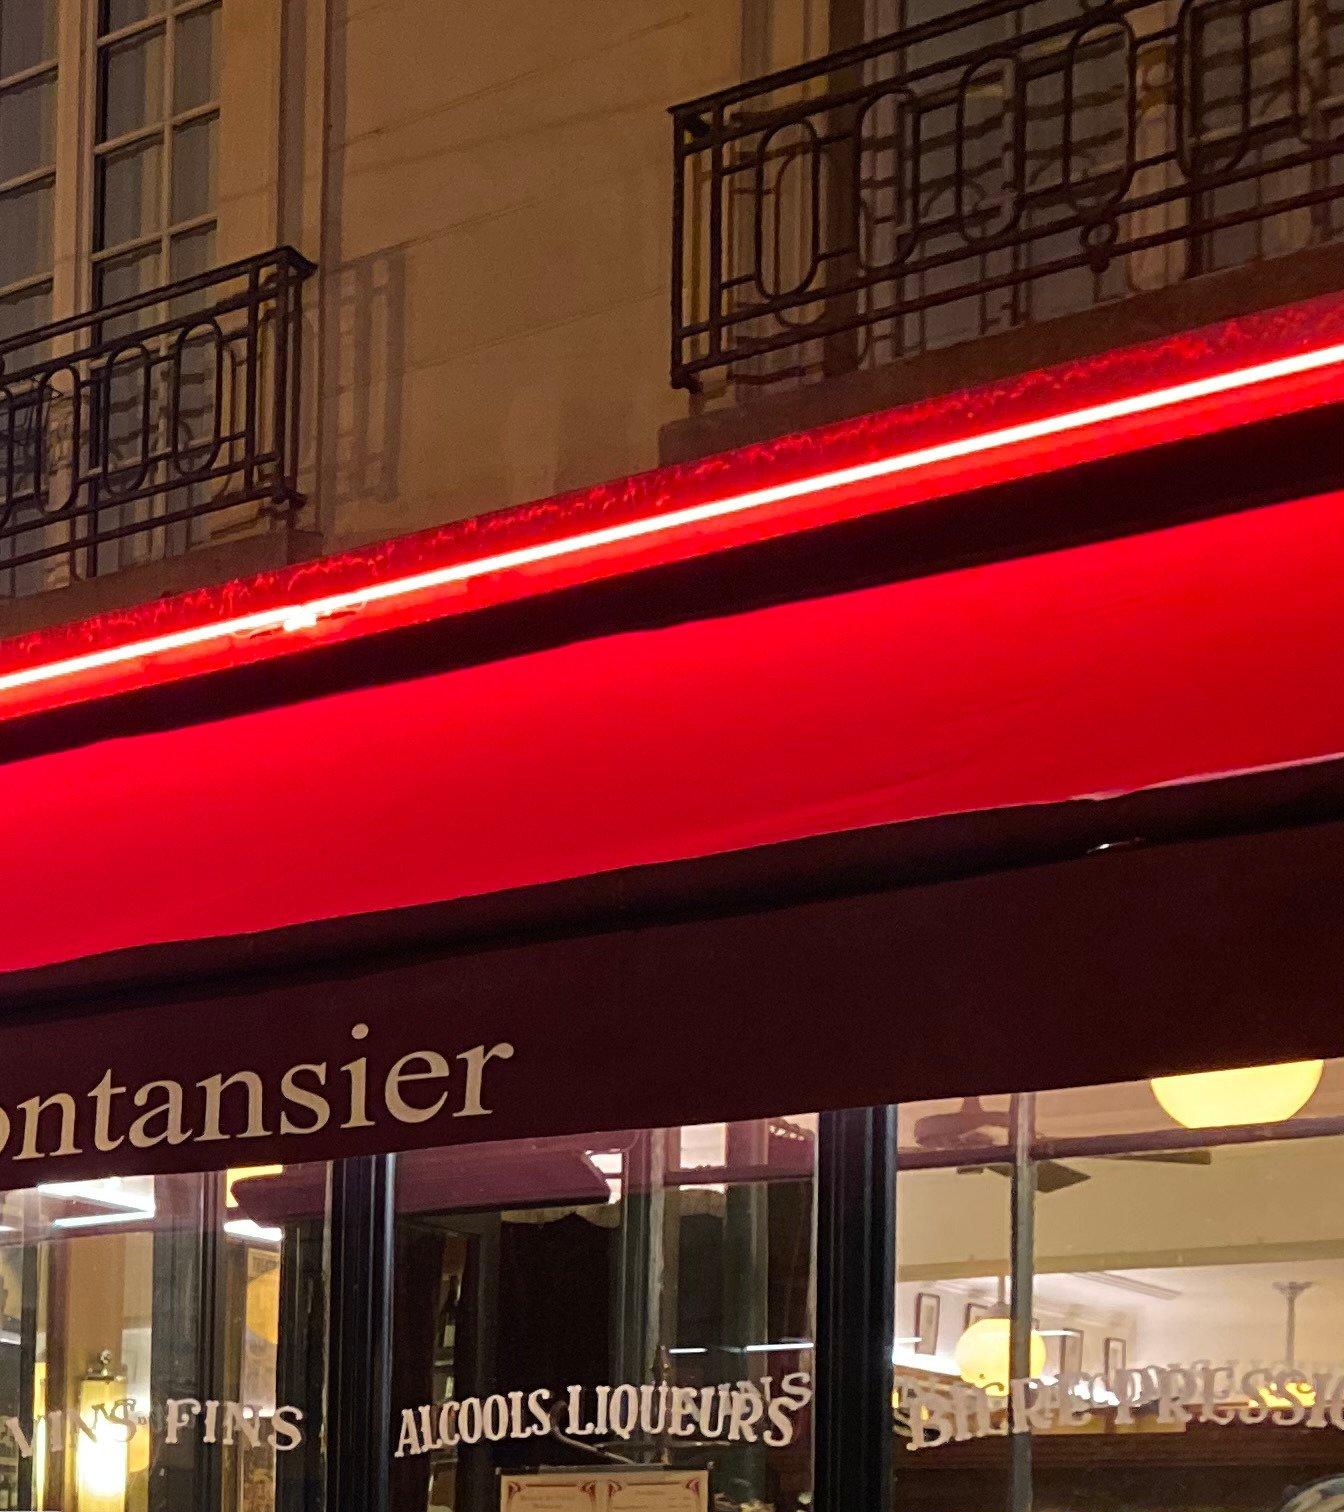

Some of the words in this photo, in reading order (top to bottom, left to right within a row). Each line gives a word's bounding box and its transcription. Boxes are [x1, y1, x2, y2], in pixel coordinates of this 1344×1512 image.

[165, 1397, 304, 1452] FINS
[393, 1387, 551, 1459] ALCOOLS
[565, 1382, 794, 1448] LIQUEURS
